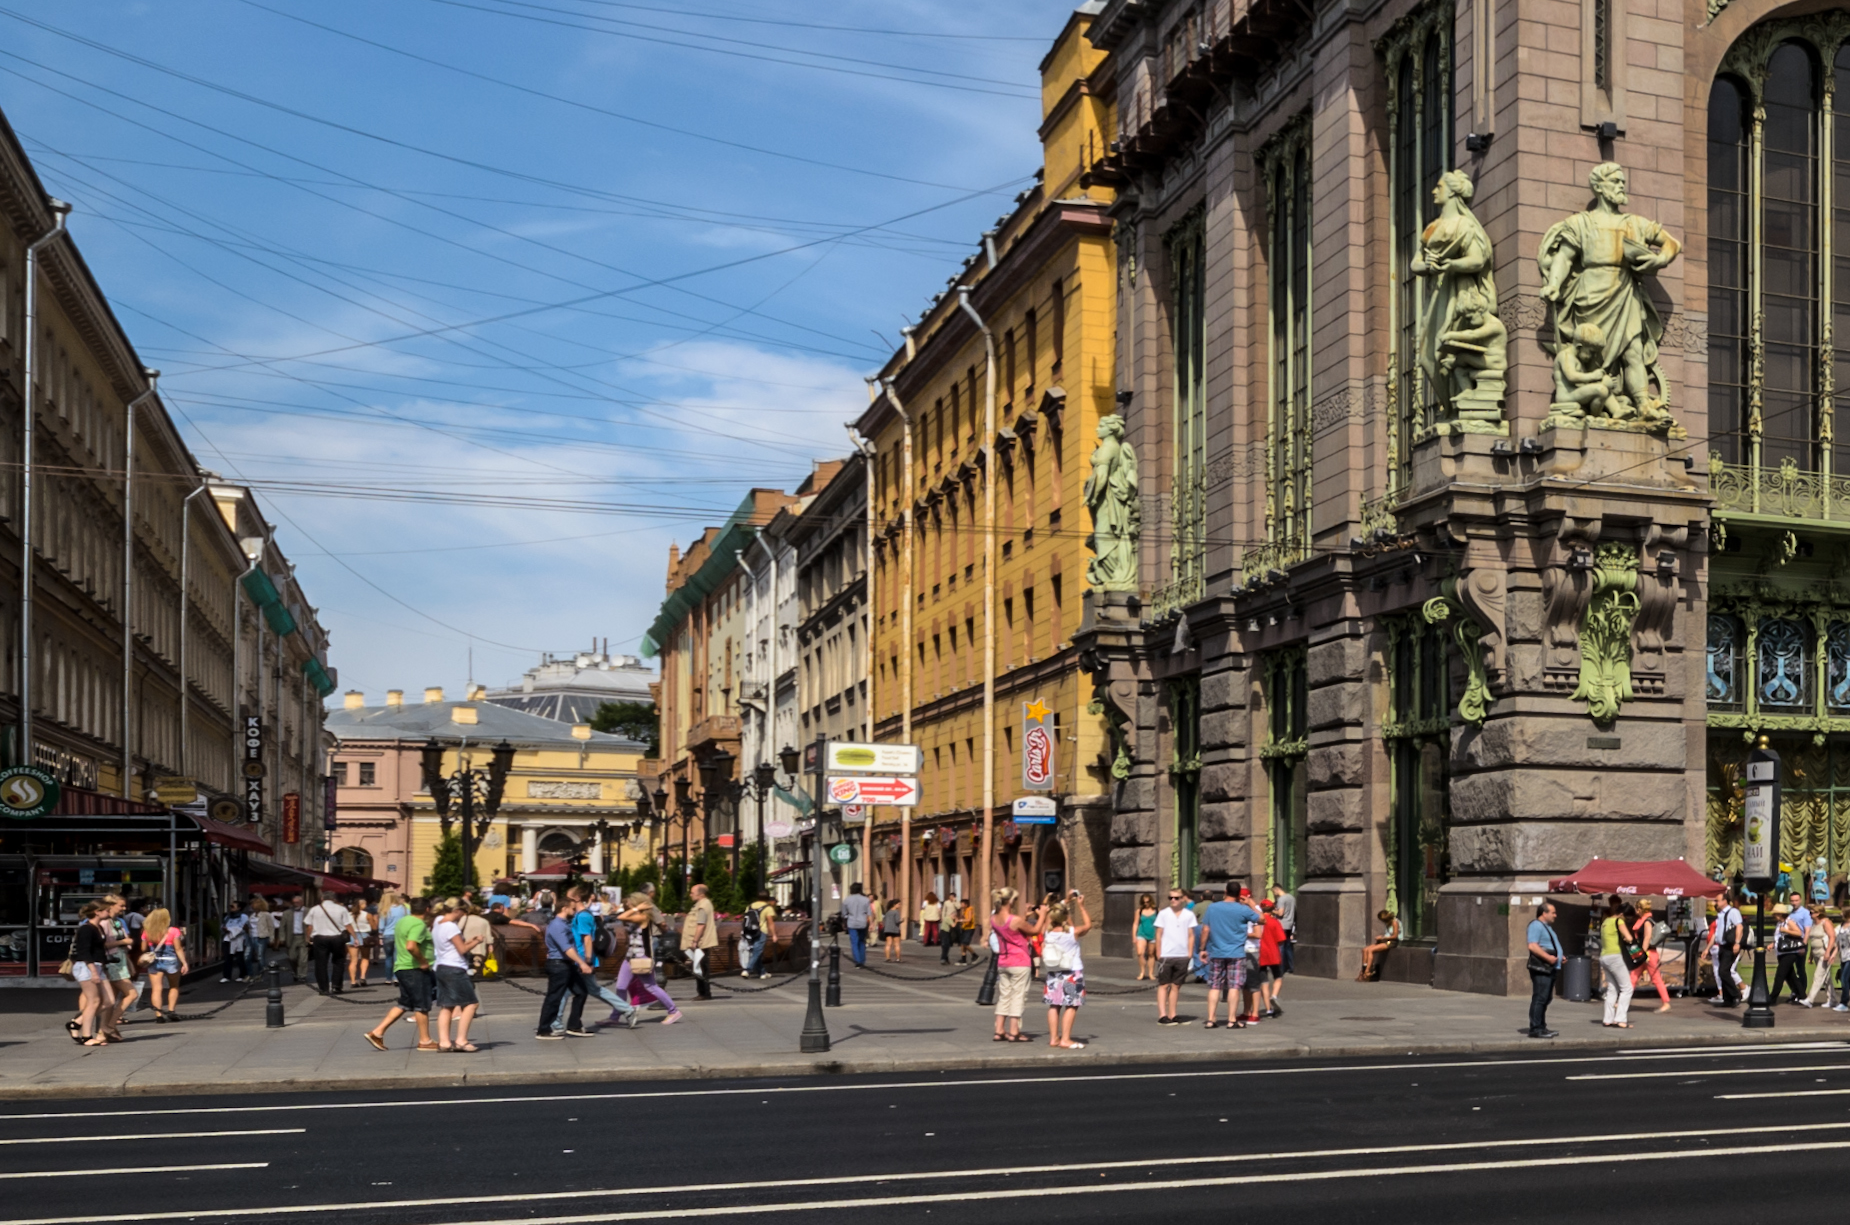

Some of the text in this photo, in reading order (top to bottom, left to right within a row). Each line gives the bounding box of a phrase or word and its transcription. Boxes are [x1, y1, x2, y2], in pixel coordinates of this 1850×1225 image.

[246, 717, 260, 822] КОФЕ ХАУЗ
[834, 785, 857, 798] KING
